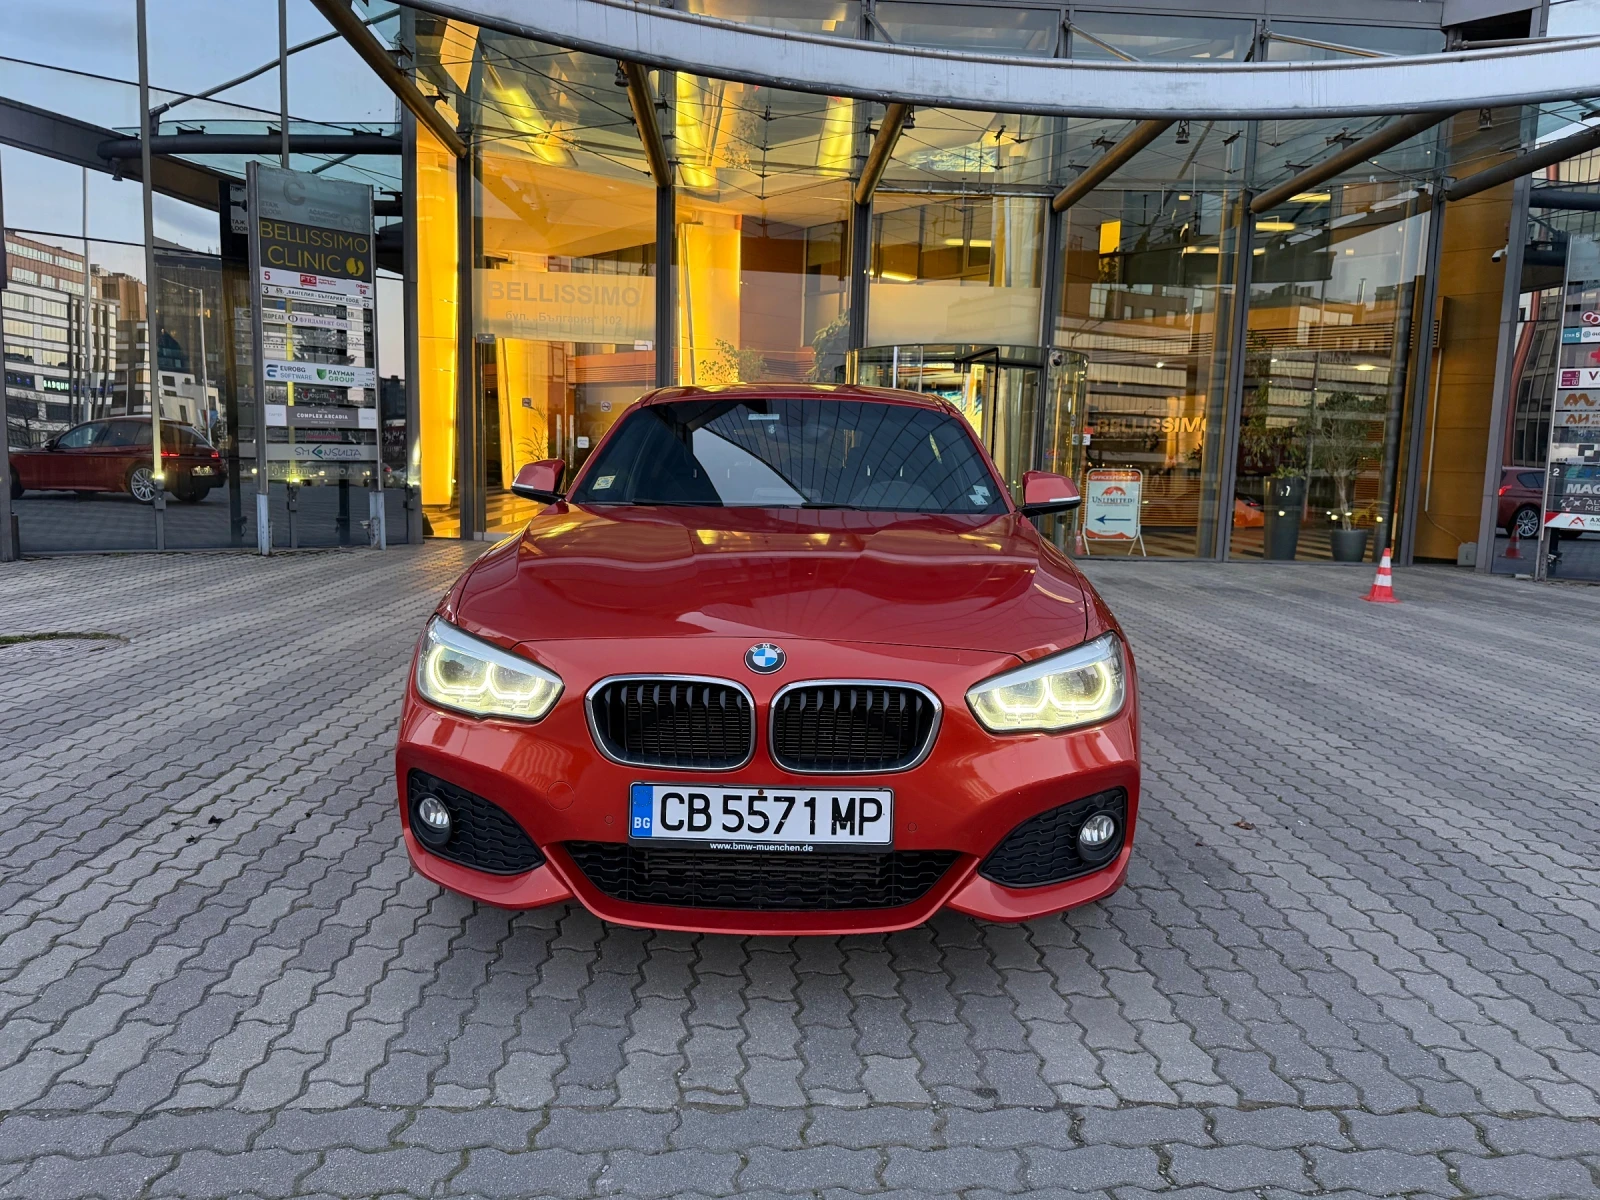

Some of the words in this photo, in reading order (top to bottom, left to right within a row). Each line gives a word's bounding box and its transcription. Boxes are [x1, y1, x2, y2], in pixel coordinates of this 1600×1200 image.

[260, 221, 368, 253] BELLISSIMO
[267, 245, 341, 273] CLINIC
[264, 271, 271, 280] 5
[300, 276, 317, 284] FTS
[263, 286, 270, 294] 3
[488, 281, 640, 307] BELLISSIMO
[505, 311, 529, 321] бул.
[604, 316, 622, 325] 102
[280, 365, 306, 373] EUROBG
[328, 369, 355, 377] PAYMAN
[280, 372, 312, 380] SOFTWARE
[1552, 468, 1560, 476] 2
[660, 791, 712, 832] CB
[722, 794, 817, 835] 5571
[831, 796, 884, 836] MP
[633, 815, 651, 829] BG
[709, 842, 814, 852] www.bmw-muenchen.de
